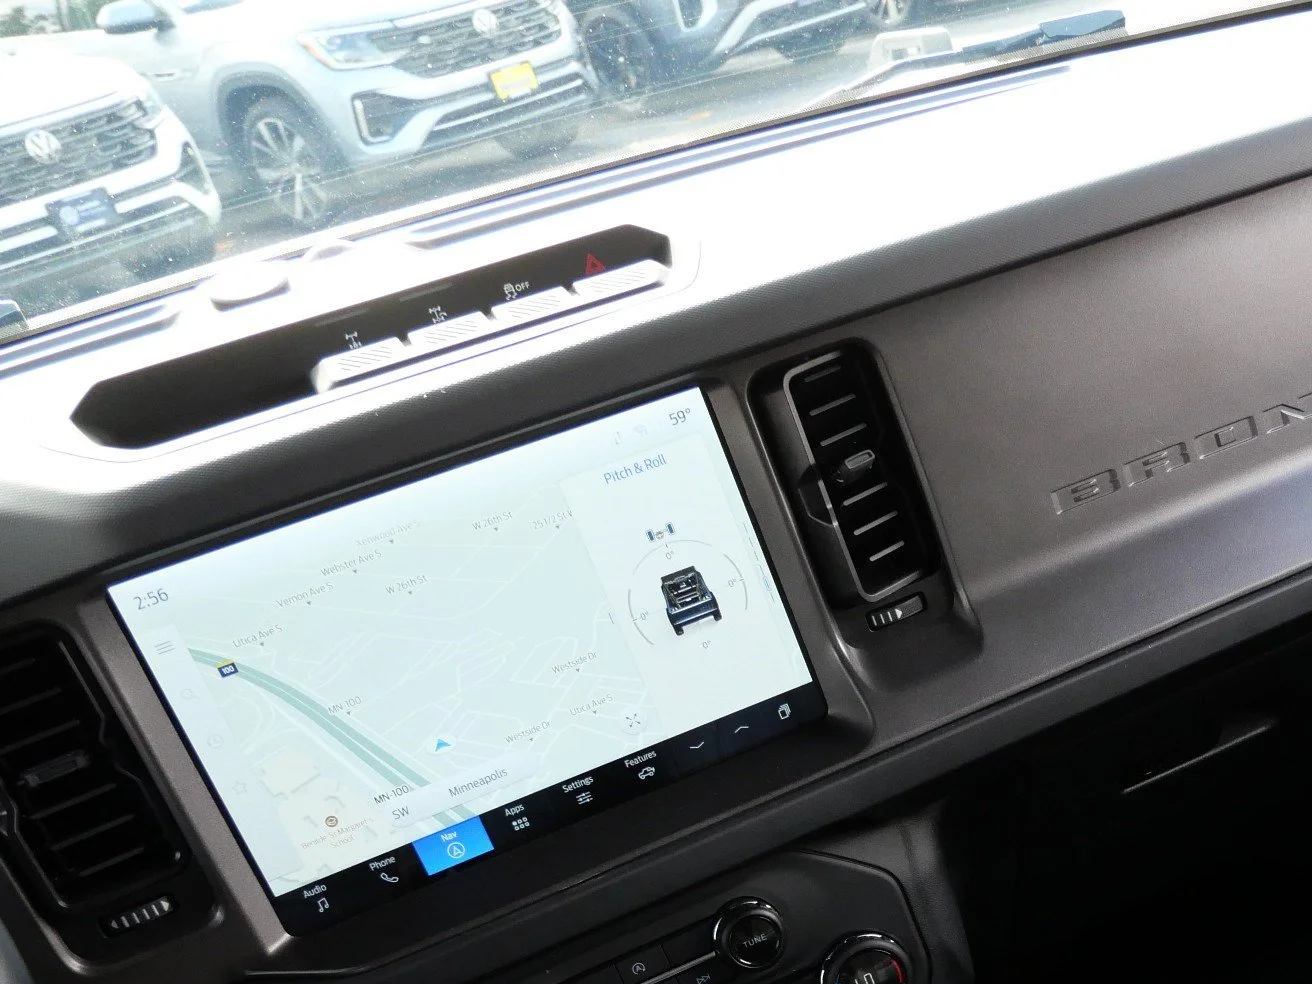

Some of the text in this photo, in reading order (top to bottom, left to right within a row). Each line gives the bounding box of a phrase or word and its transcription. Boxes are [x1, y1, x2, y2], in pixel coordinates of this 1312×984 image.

[515, 281, 530, 292] OFF
[603, 453, 667, 485] Pitch & Roll
[472, 519, 482, 531] W
[502, 510, 513, 520] St
[320, 548, 382, 577] Webster Ave S
[275, 581, 335, 608] Vernon Ave S
[385, 574, 428, 595] W 26th St
[133, 588, 169, 611] 2:56
[232, 623, 283, 649] Utica Ave S
[221, 663, 236, 675] 100
[551, 651, 598, 674] Westside Dr
[569, 693, 614, 717] Utica Ave S
[504, 719, 552, 744] Westside Dr
[624, 750, 657, 768] Features
[373, 784, 410, 805] MN-100
[391, 767, 509, 821] SW Minneapolis
[562, 776, 594, 794] Settings
[504, 804, 525, 817] Apps
[440, 830, 458, 843] Nav
[368, 856, 397, 872] Phone
[303, 884, 328, 899] Audio
[742, 933, 768, 949] TUNE
